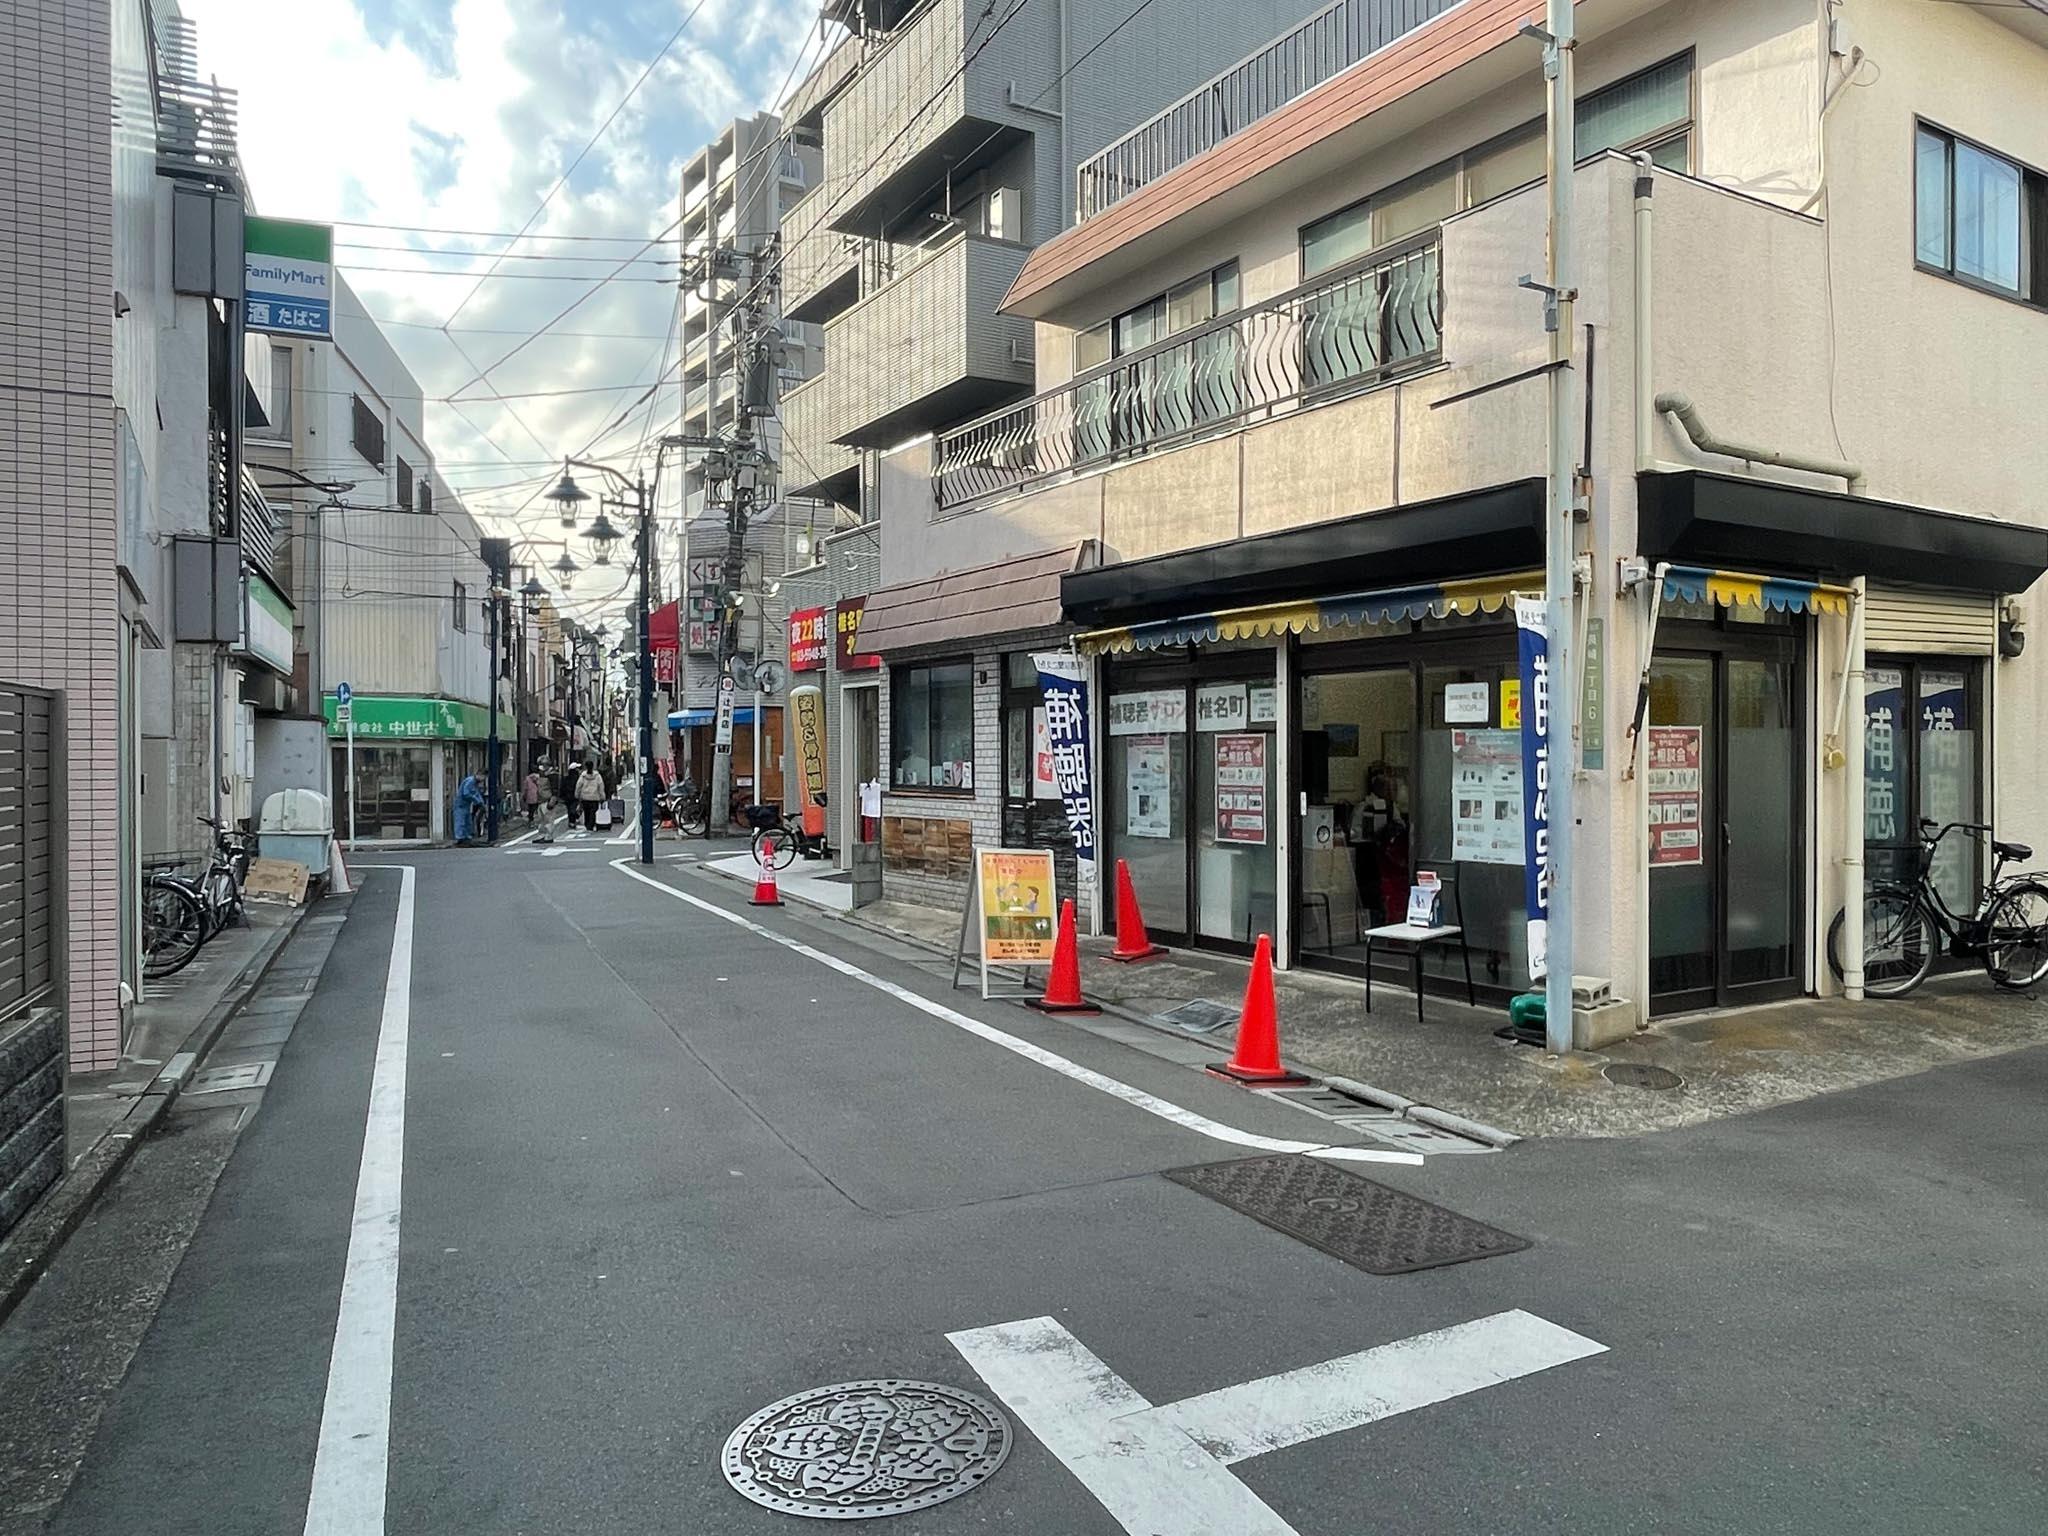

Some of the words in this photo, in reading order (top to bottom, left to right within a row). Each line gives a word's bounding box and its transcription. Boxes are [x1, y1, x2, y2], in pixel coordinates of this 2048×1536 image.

[246, 264, 326, 286] FamilyMart
[248, 302, 270, 325] 酒
[278, 308, 321, 328] たばこ
[1109, 700, 1185, 724] 補聴器サロン
[1198, 695, 1244, 720] 椎名町
